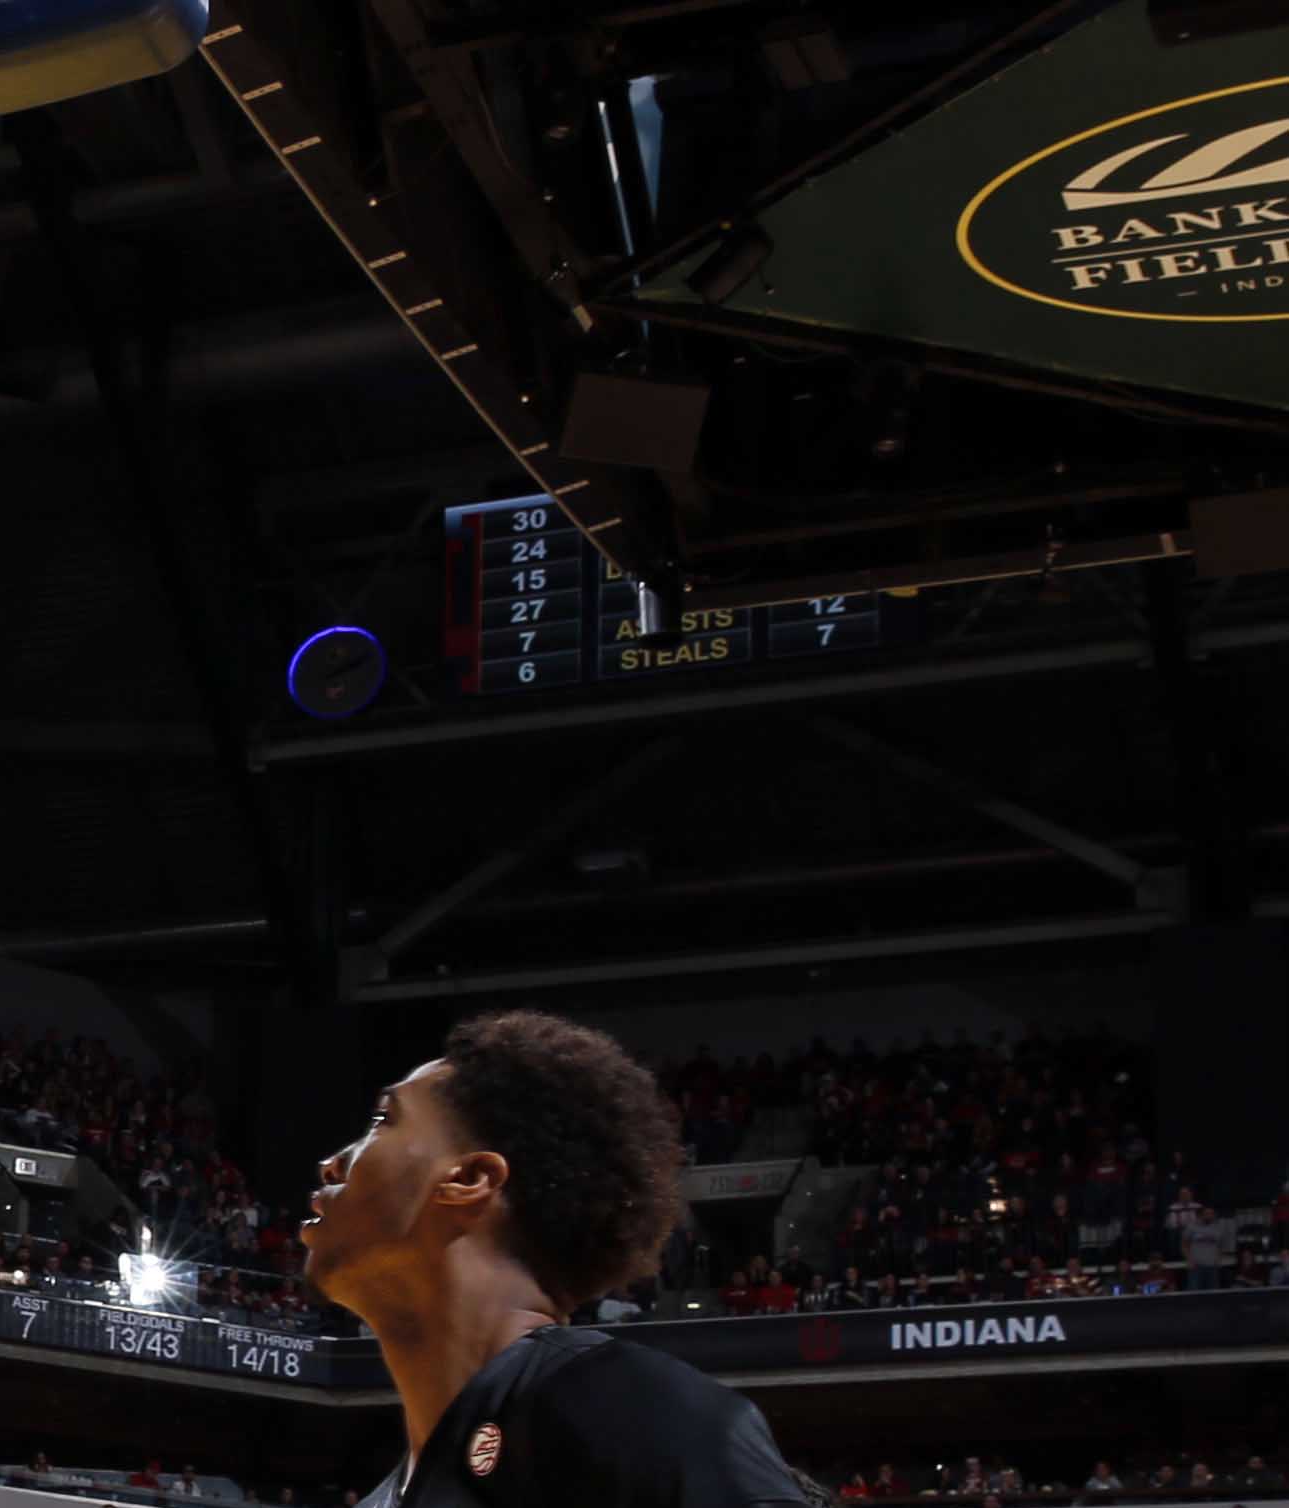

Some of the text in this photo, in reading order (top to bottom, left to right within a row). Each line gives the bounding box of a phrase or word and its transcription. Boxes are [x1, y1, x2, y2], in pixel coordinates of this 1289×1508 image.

[512, 509, 547, 533] 30
[512, 538, 548, 564] 24
[512, 569, 546, 593] 15
[511, 598, 546, 624] 27
[519, 632, 536, 654] 7
[519, 624, 837, 683] 6 STEALS 7
[12, 1296, 49, 1312] ASST
[19, 1311, 36, 1339] 7
[890, 1314, 1066, 1350] INDIANA
[105, 1326, 180, 1360] 13/43
[218, 1327, 314, 1353] FREE THROWS
[227, 1344, 300, 1377] 14/18
